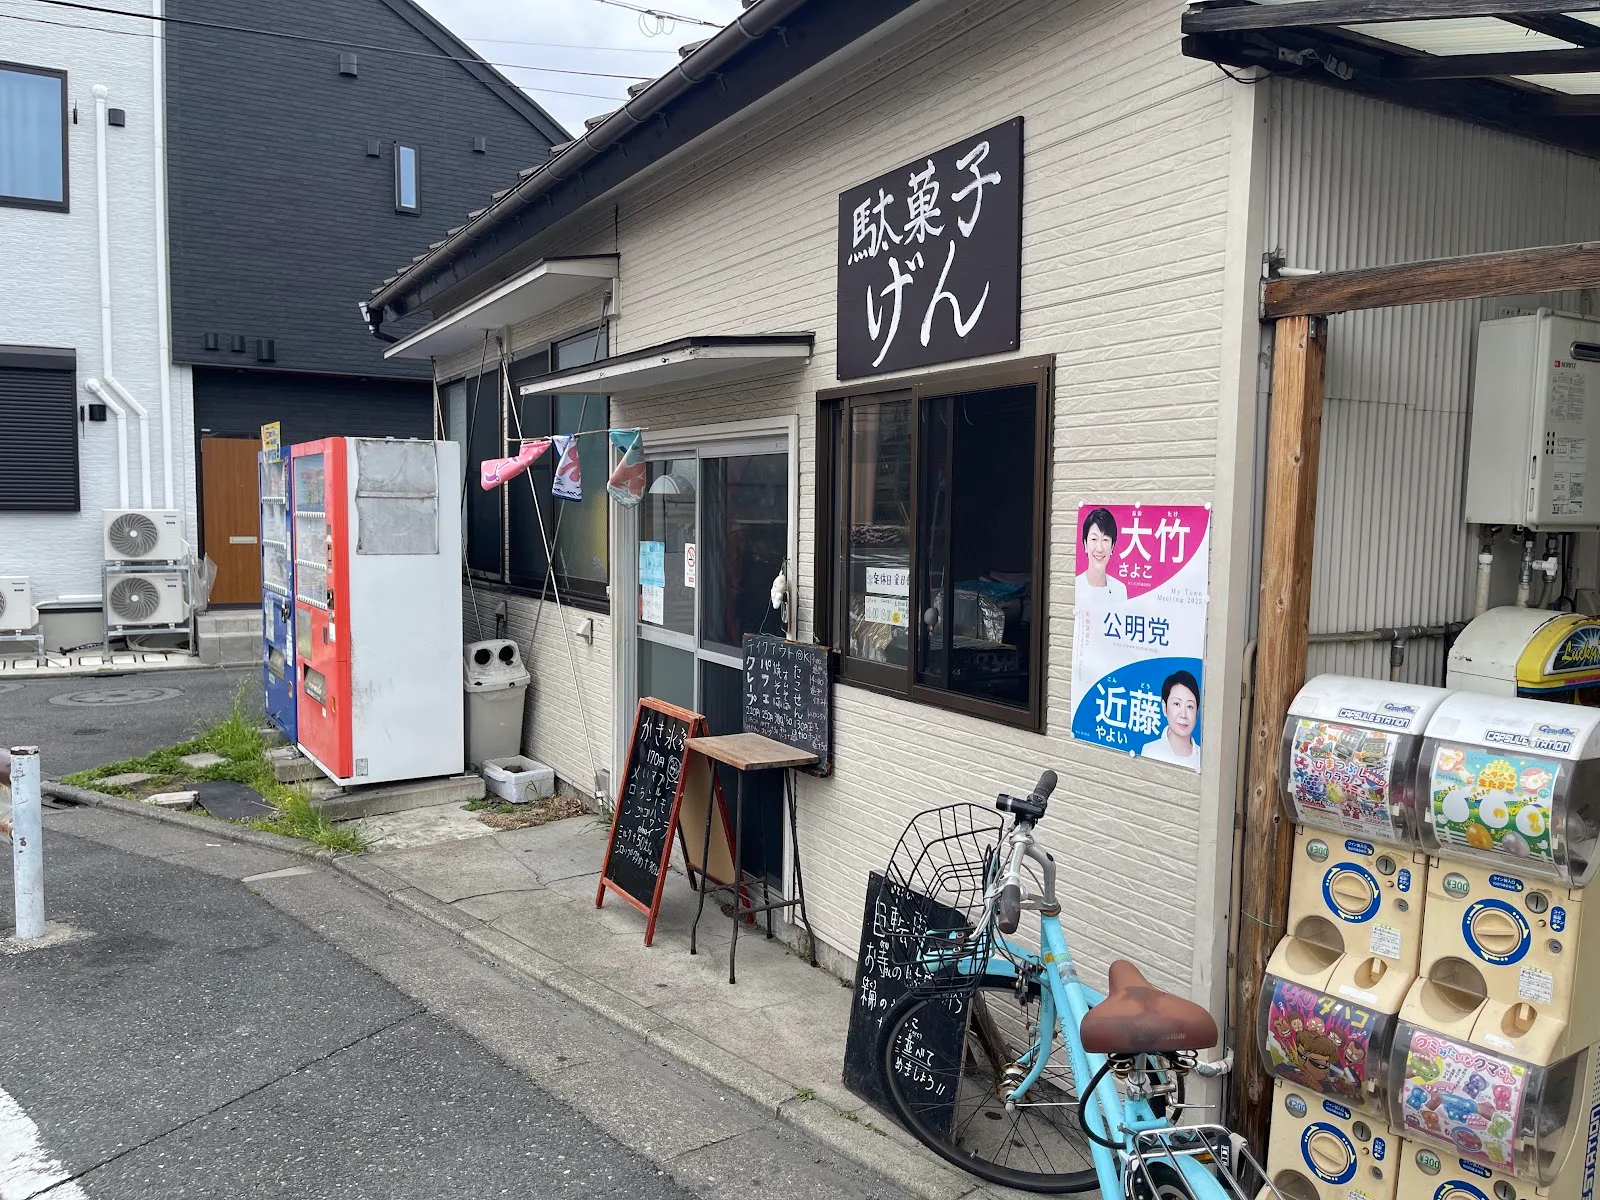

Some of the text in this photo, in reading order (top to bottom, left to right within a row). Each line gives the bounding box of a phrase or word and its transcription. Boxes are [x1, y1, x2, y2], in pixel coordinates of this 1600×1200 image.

[848, 140, 1001, 266] 駄菓子
[867, 239, 990, 368] げん
[1119, 517, 1190, 564] 大竹
[1118, 562, 1153, 579] さよこ
[1171, 588, 1203, 597] My Town
[1103, 612, 1170, 647] 公明党
[1562, 639, 1598, 663] Lucky
[746, 656, 757, 705] クレープ
[760, 658, 773, 704] パフェ
[1095, 682, 1162, 736] 近藤
[1337, 708, 1411, 728] CAPSULE STATION
[640, 716, 678, 751] かき氷
[1095, 725, 1128, 744] やよい
[1485, 731, 1529, 746] CAPSULE
[1309, 845, 1328, 857] ¥300
[1446, 878, 1468, 892] ¥300
[1415, 1034, 1517, 1084] グミみたいなクマさん
[1419, 1153, 1440, 1170] ¥300
